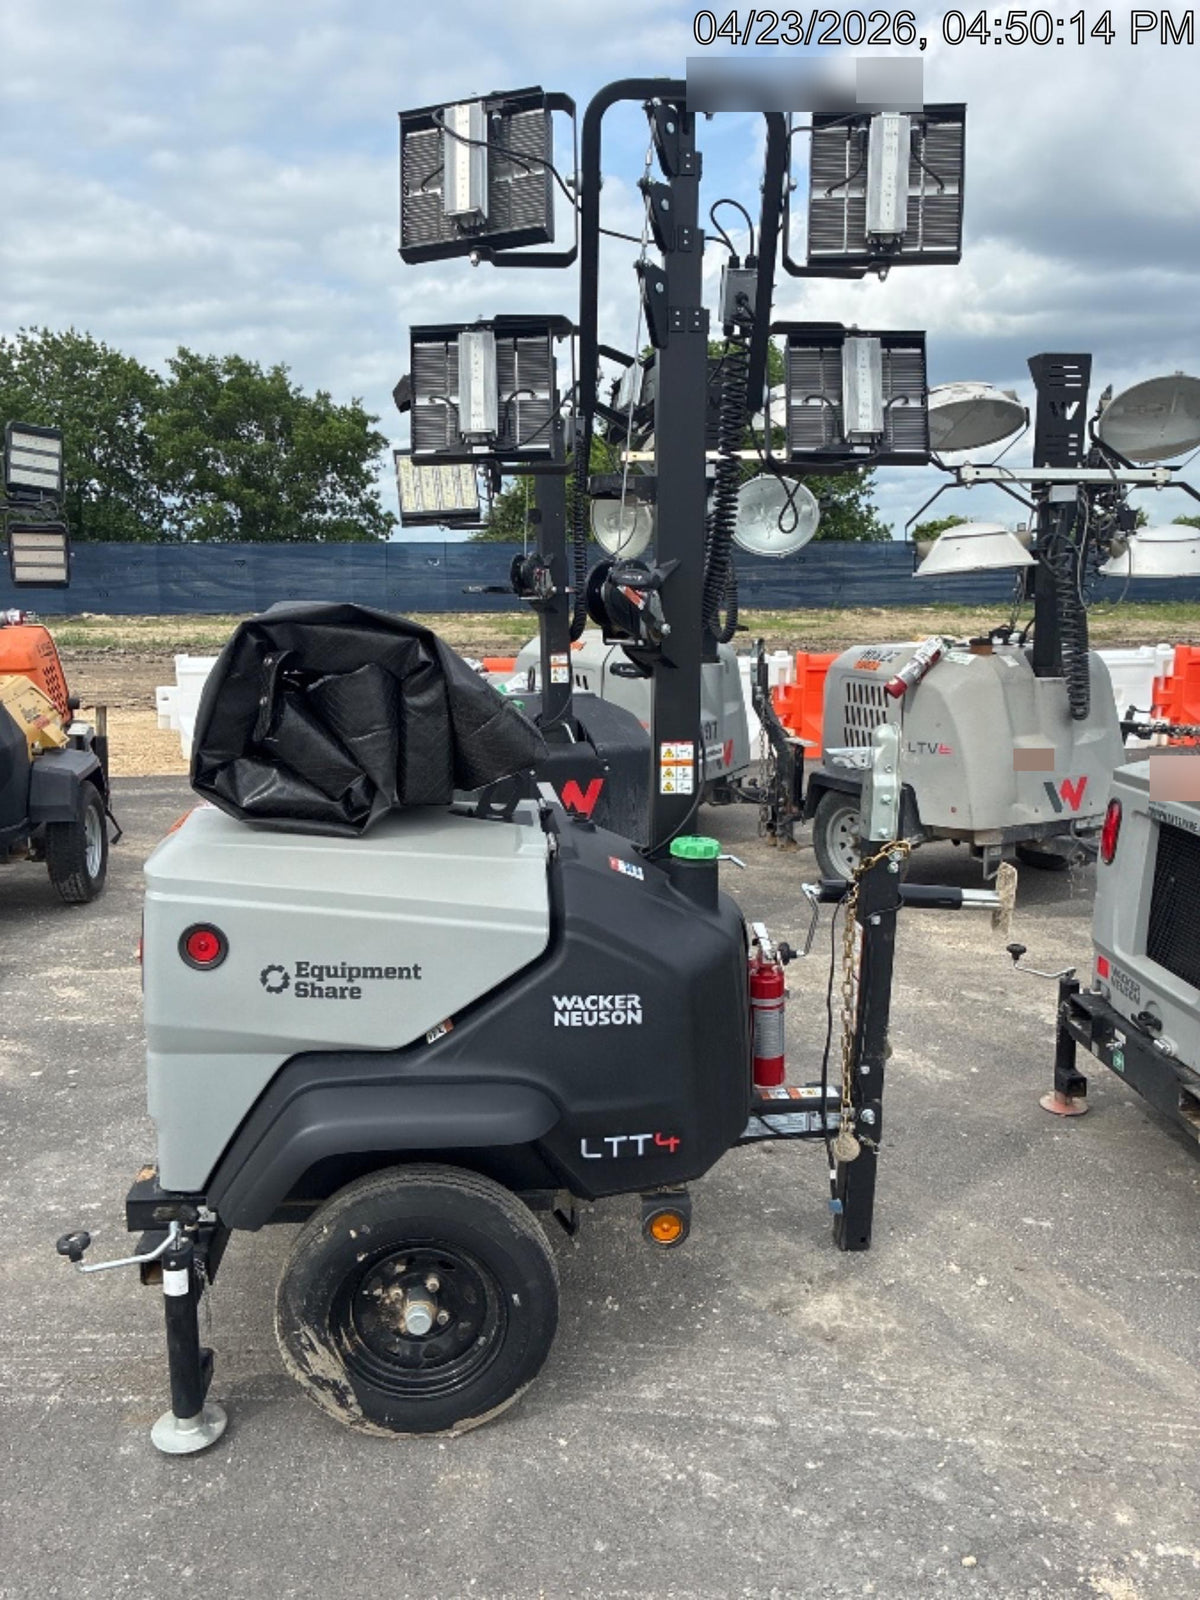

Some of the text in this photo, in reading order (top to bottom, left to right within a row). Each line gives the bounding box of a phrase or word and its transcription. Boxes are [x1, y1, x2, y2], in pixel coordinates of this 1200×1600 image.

[294, 961, 422, 983] Equipment
[294, 981, 362, 1000] Share
[552, 994, 643, 1011] WACKER
[553, 1010, 643, 1027] NEUSON
[580, 1132, 680, 1158] LTT4
